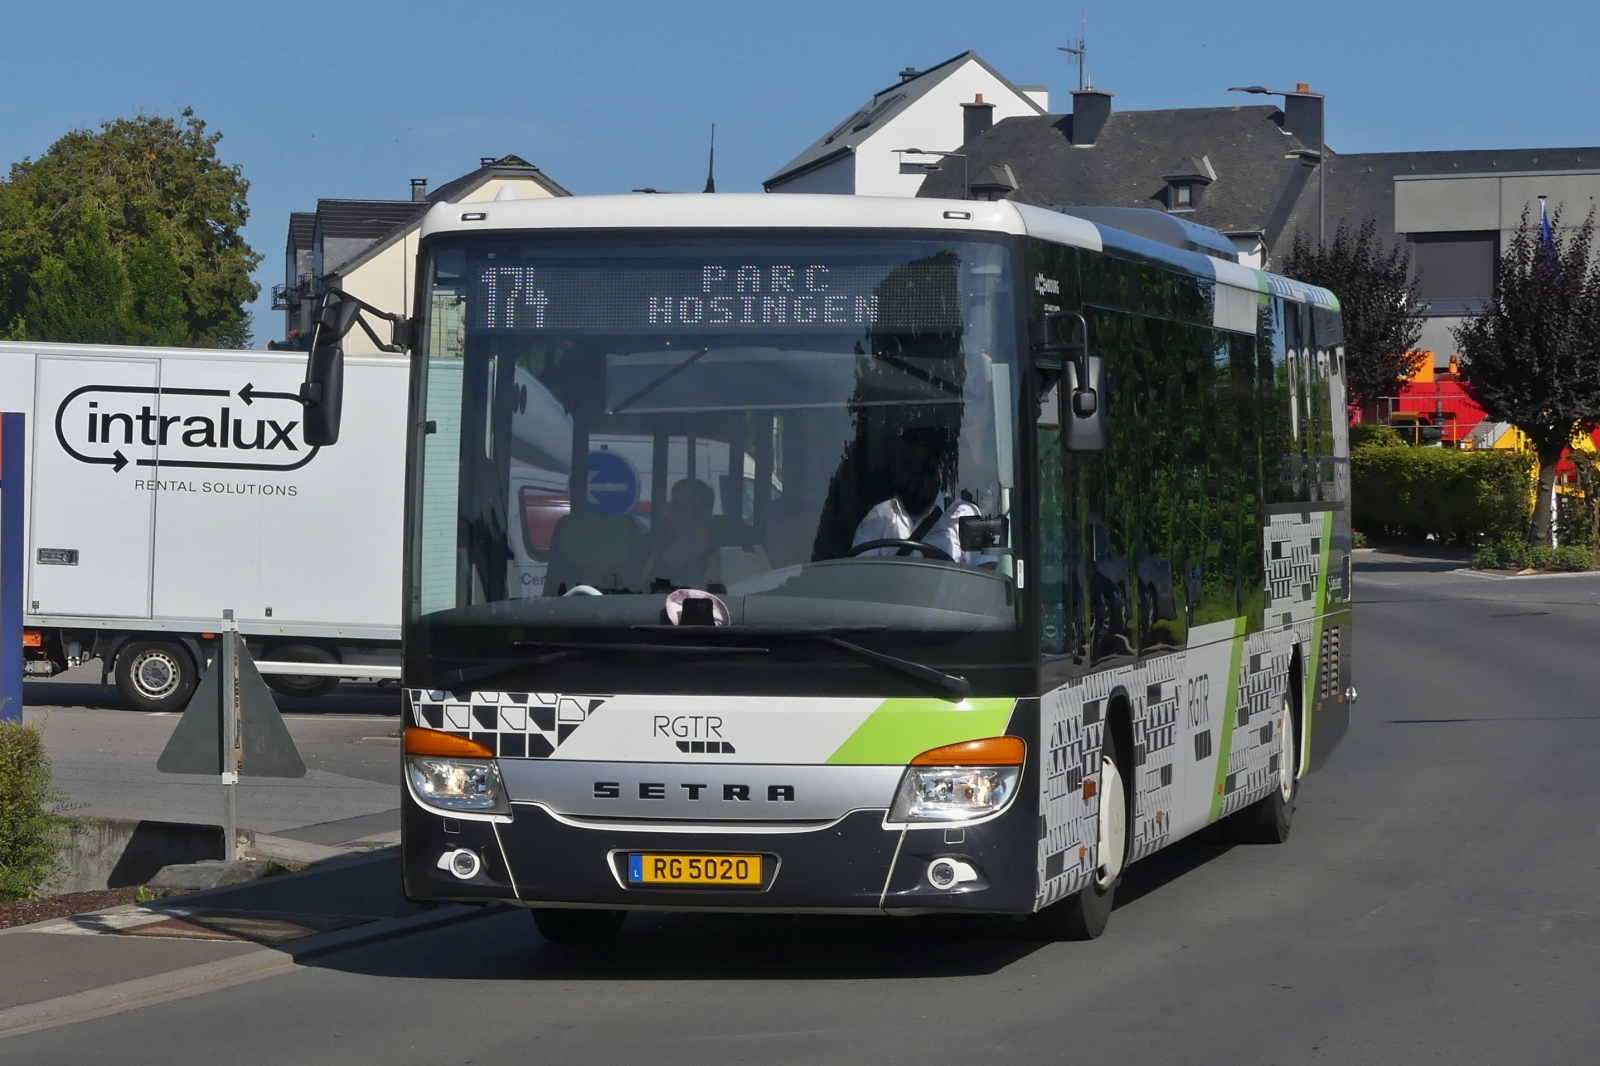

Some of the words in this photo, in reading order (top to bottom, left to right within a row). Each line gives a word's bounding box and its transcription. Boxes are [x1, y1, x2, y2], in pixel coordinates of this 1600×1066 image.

[703, 265, 829, 292] PARC
[481, 267, 548, 328] 174
[649, 296, 879, 323] HOSINGEN
[87, 401, 300, 451] intralux
[134, 479, 197, 493] RENTAL
[202, 481, 299, 497] SOLUTIONS
[1187, 673, 1210, 730] RGTR
[653, 715, 723, 738] RGTR
[593, 781, 795, 802] SETRA
[634, 870, 640, 878] L
[653, 858, 683, 879] RG
[688, 858, 749, 880] 5020
